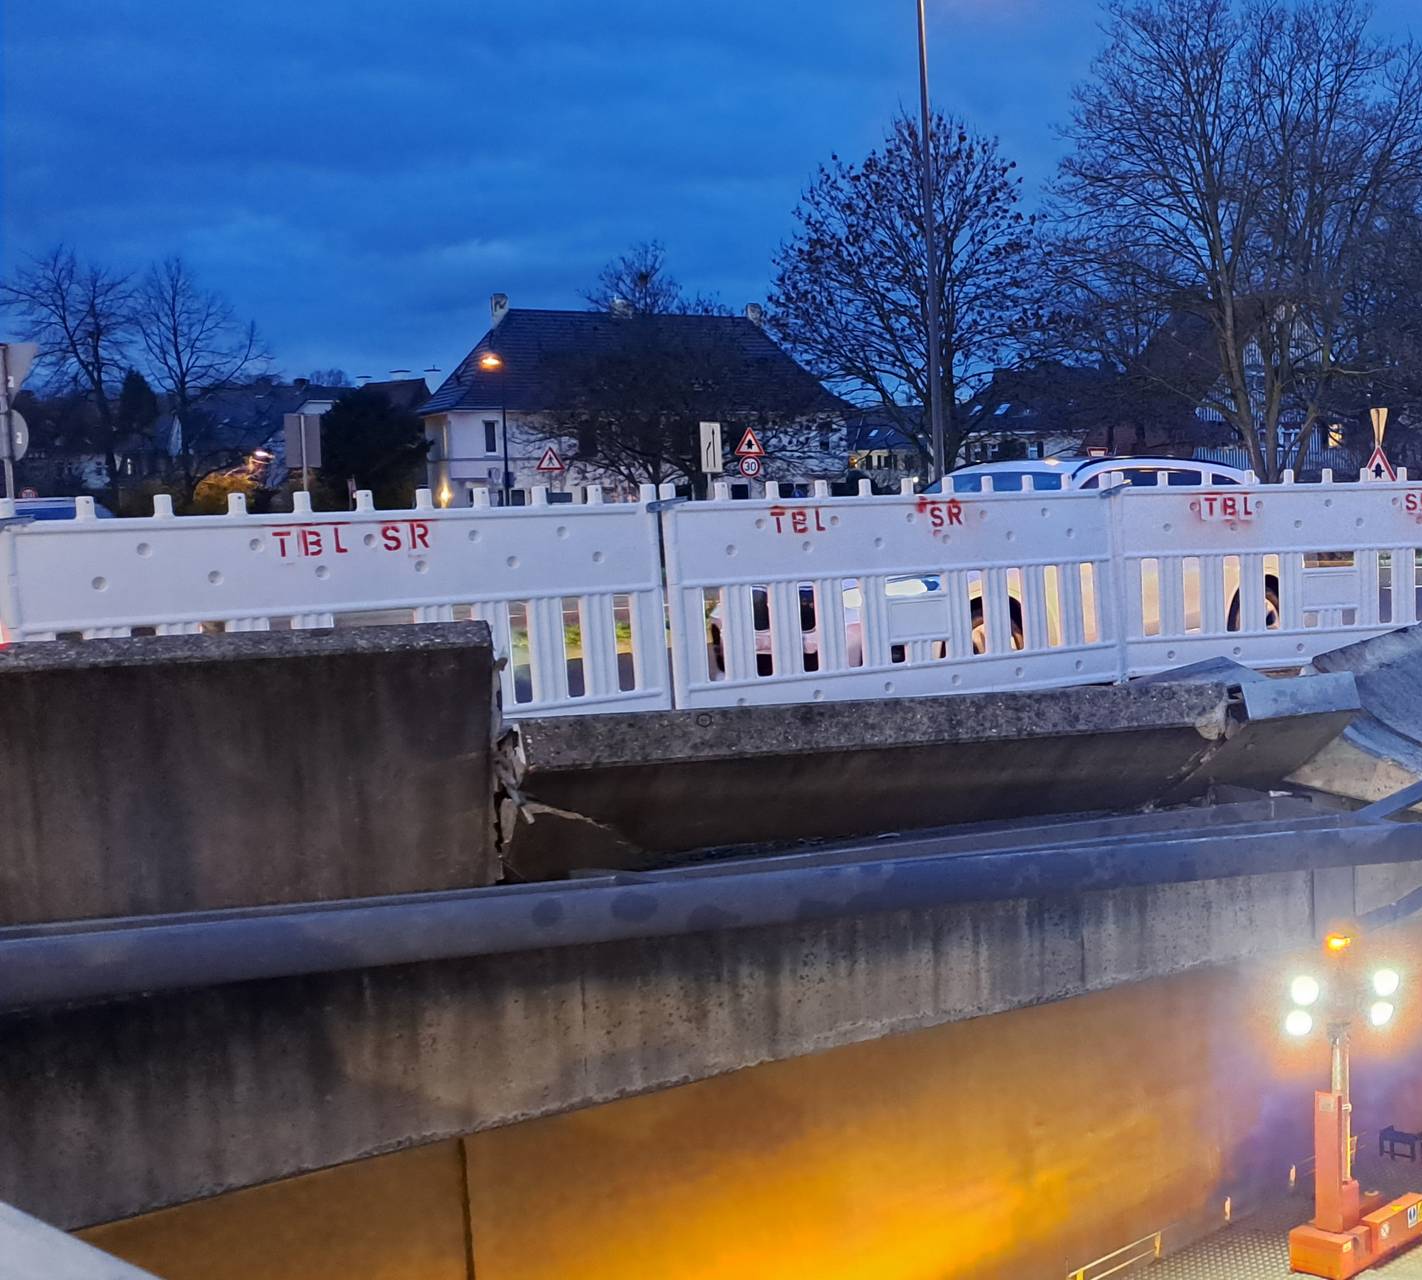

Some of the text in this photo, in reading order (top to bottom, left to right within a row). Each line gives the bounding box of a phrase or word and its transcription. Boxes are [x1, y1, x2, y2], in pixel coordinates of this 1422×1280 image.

[744, 461, 757, 472] 30
[770, 503, 963, 534] TBL SR
[1204, 496, 1253, 517] TBL
[271, 523, 430, 558] TBL SR
